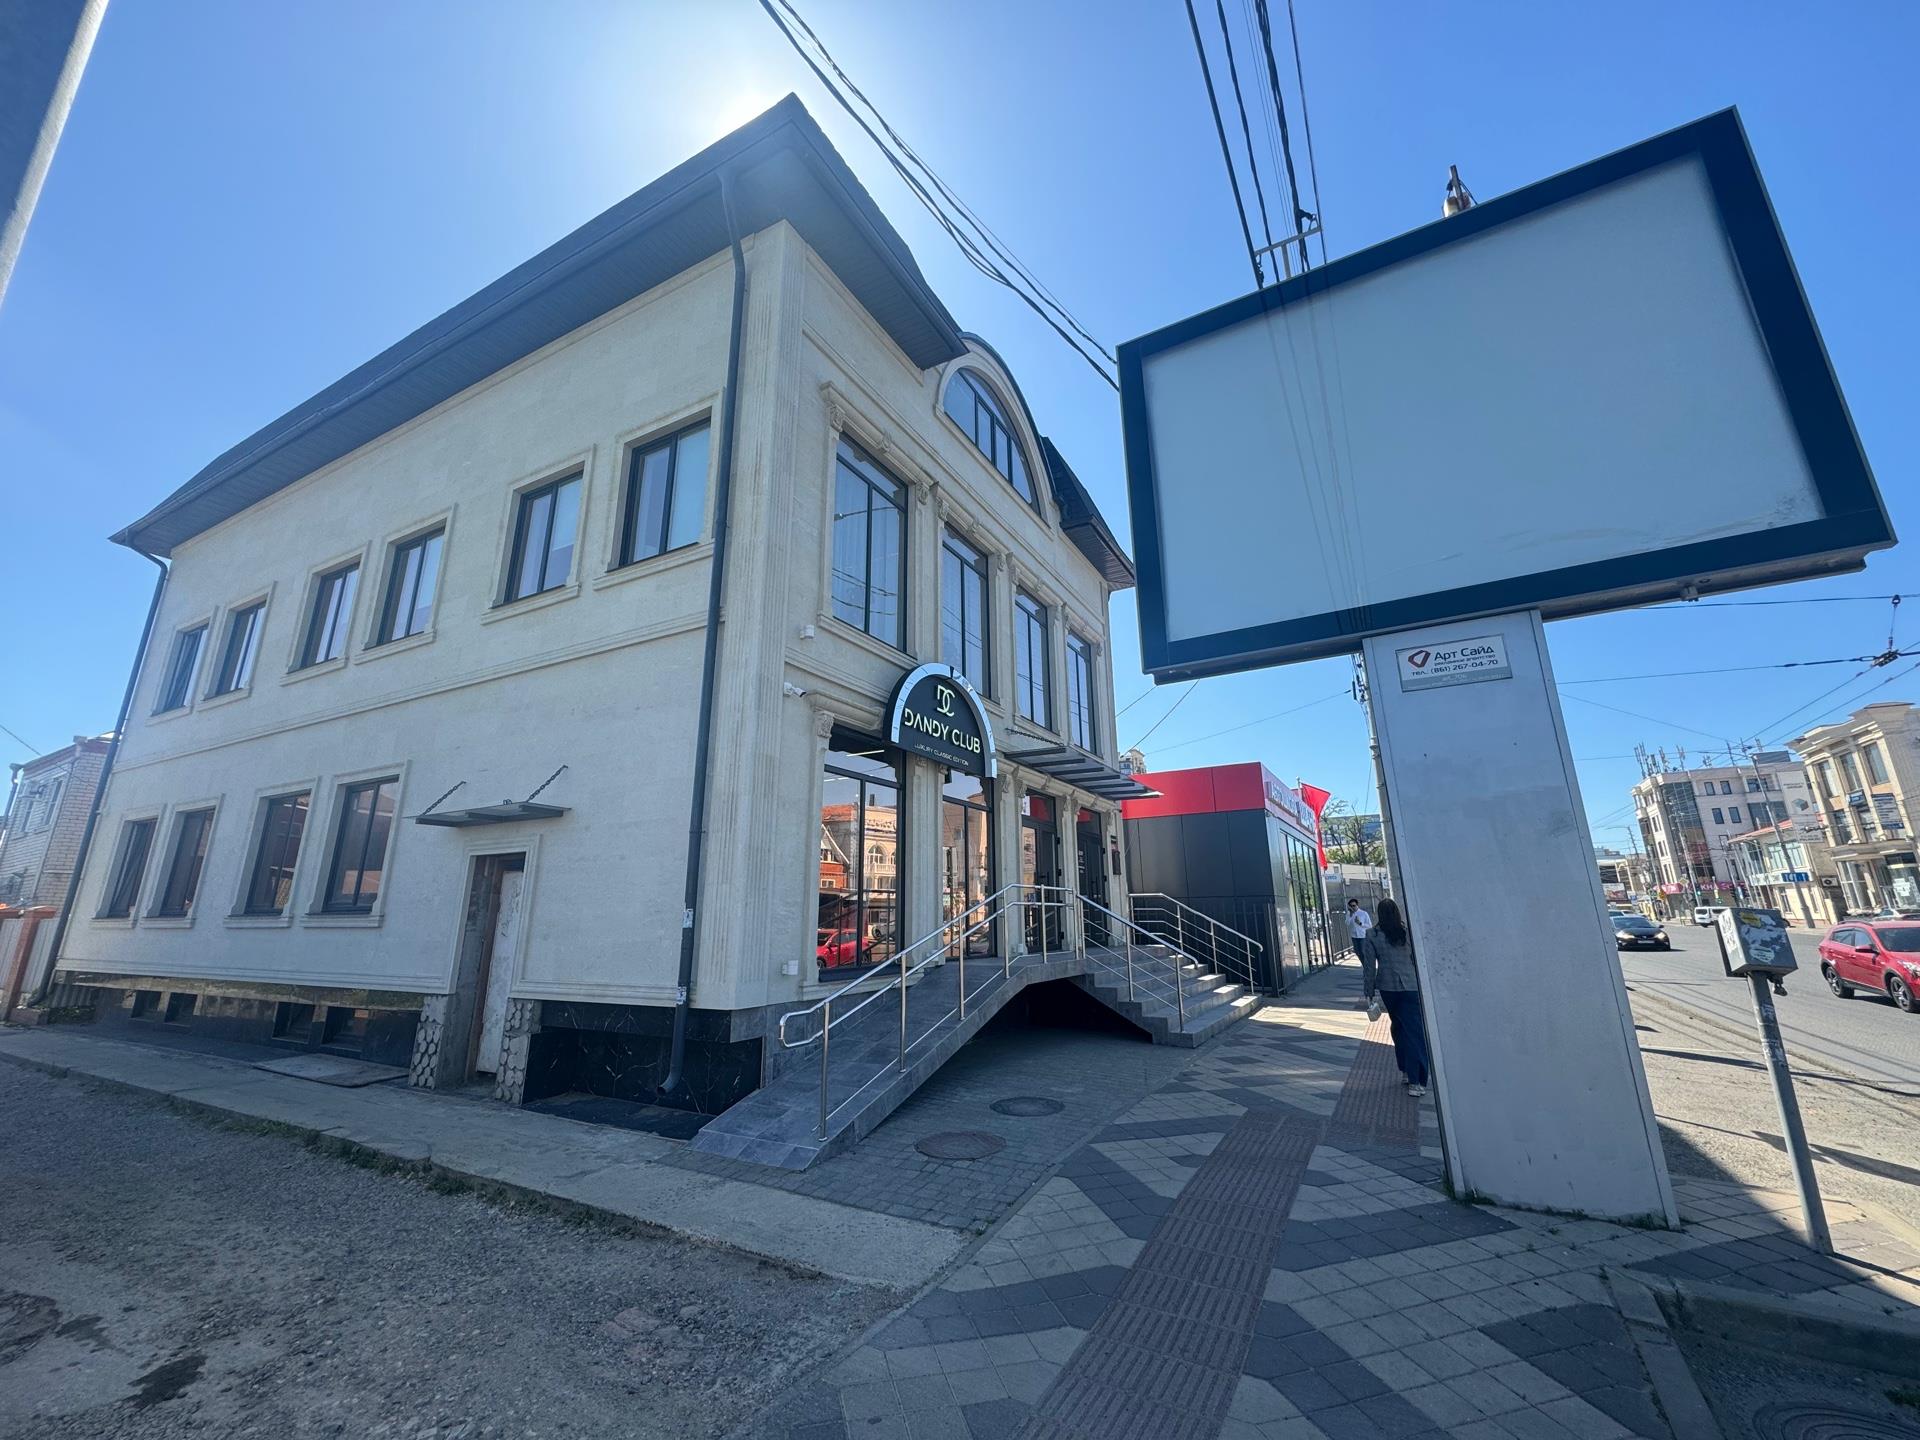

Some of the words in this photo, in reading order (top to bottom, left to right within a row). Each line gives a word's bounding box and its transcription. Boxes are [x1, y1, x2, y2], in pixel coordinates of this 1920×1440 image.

[1434, 651, 1458, 662] Арт
[1460, 646, 1494, 656] Сайд
[1430, 665, 1451, 674] (861)
[1452, 660, 1498, 670] 267-04-70
[904, 708, 949, 740] DANDY
[952, 729, 981, 754] CLUB
[933, 749, 953, 761] CLASSIC
[952, 756, 969, 766] EDITION
